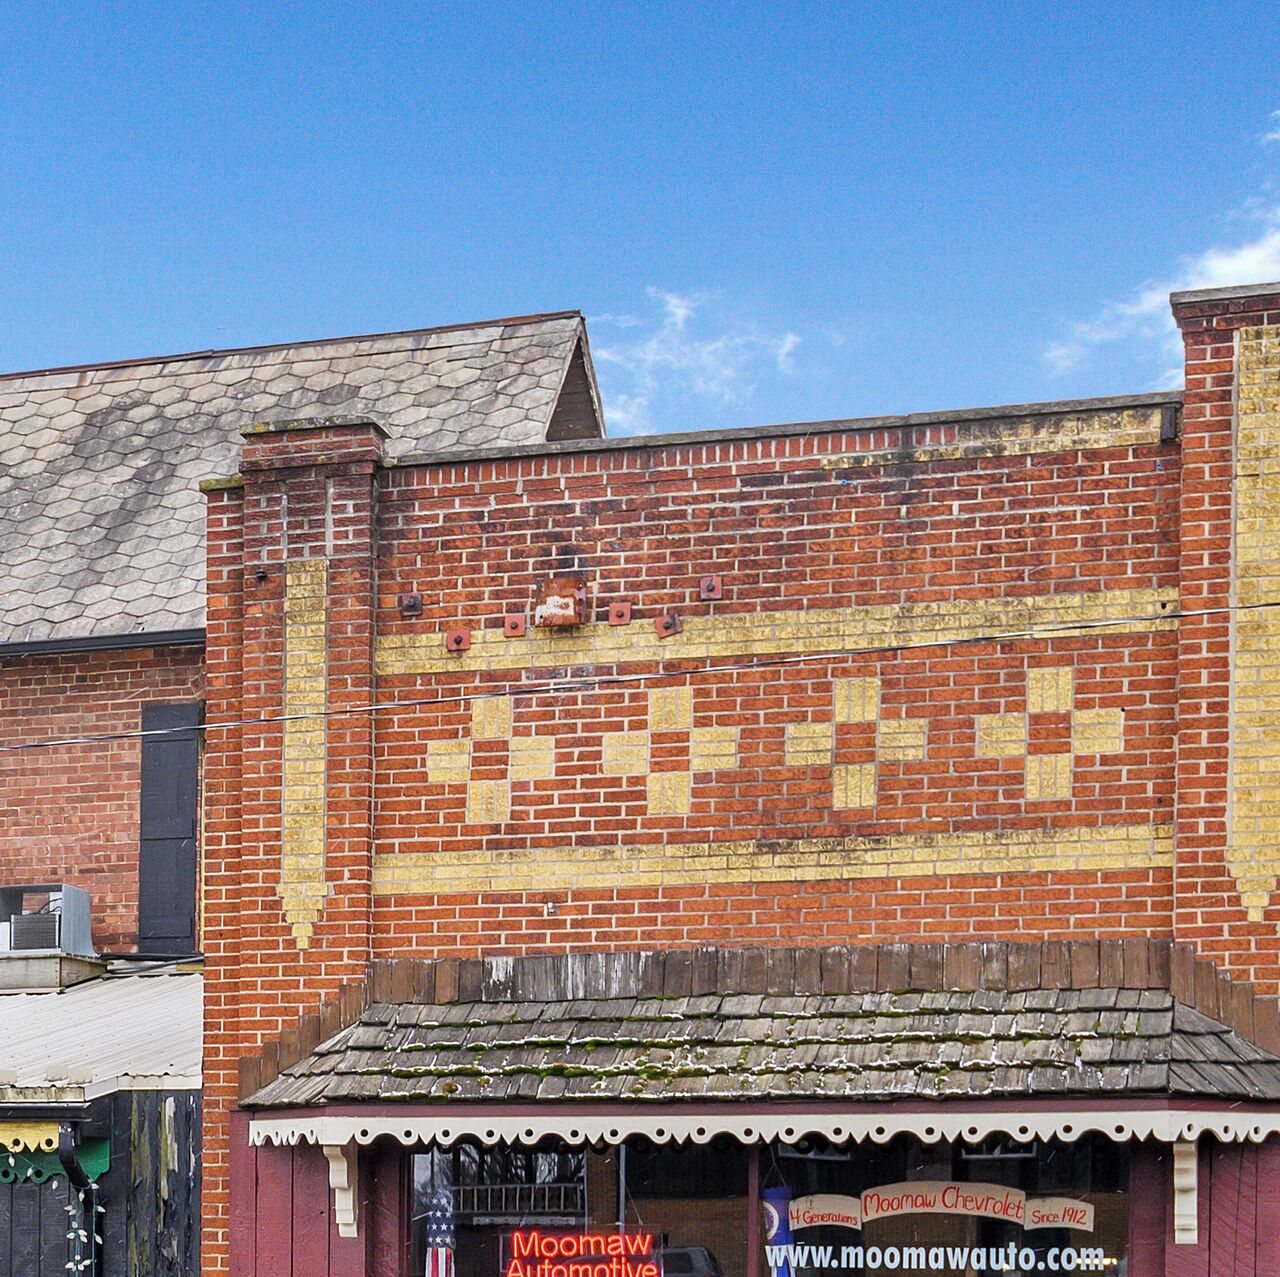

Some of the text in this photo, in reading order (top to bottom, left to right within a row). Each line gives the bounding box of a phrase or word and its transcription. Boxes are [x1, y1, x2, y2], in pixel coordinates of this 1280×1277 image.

[862, 1184, 1024, 1220] Moomaw Chevrolet
[1031, 1206, 1088, 1225] Since 1912
[790, 1207, 858, 1226] 4 Generations
[513, 1231, 652, 1258] Moomaw
[765, 1242, 1105, 1271] www.moomawauto.com
